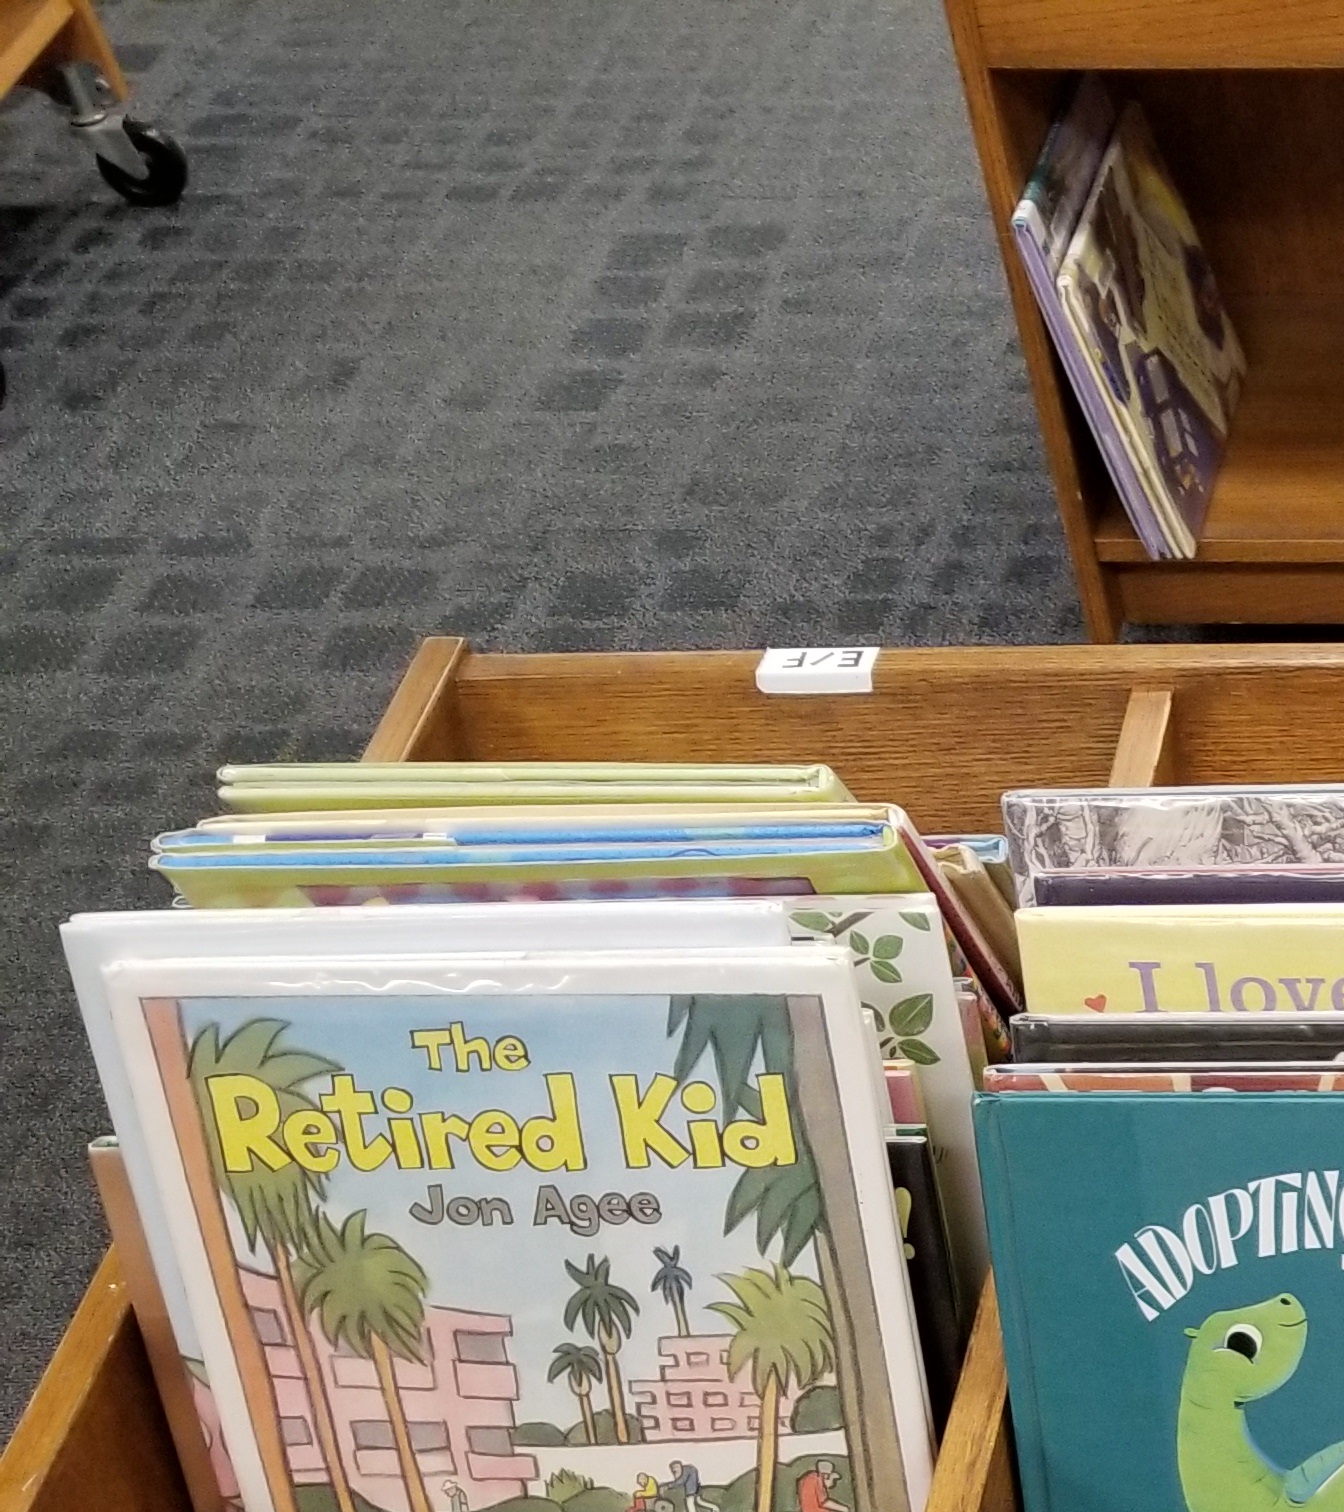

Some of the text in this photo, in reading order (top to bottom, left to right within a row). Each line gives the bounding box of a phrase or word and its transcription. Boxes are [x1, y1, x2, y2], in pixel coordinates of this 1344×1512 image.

[1129, 961, 1163, 1013] I
[410, 1021, 532, 1073] The
[205, 1072, 797, 1173] Retired Kid
[409, 1184, 662, 1237] Jon Agee
